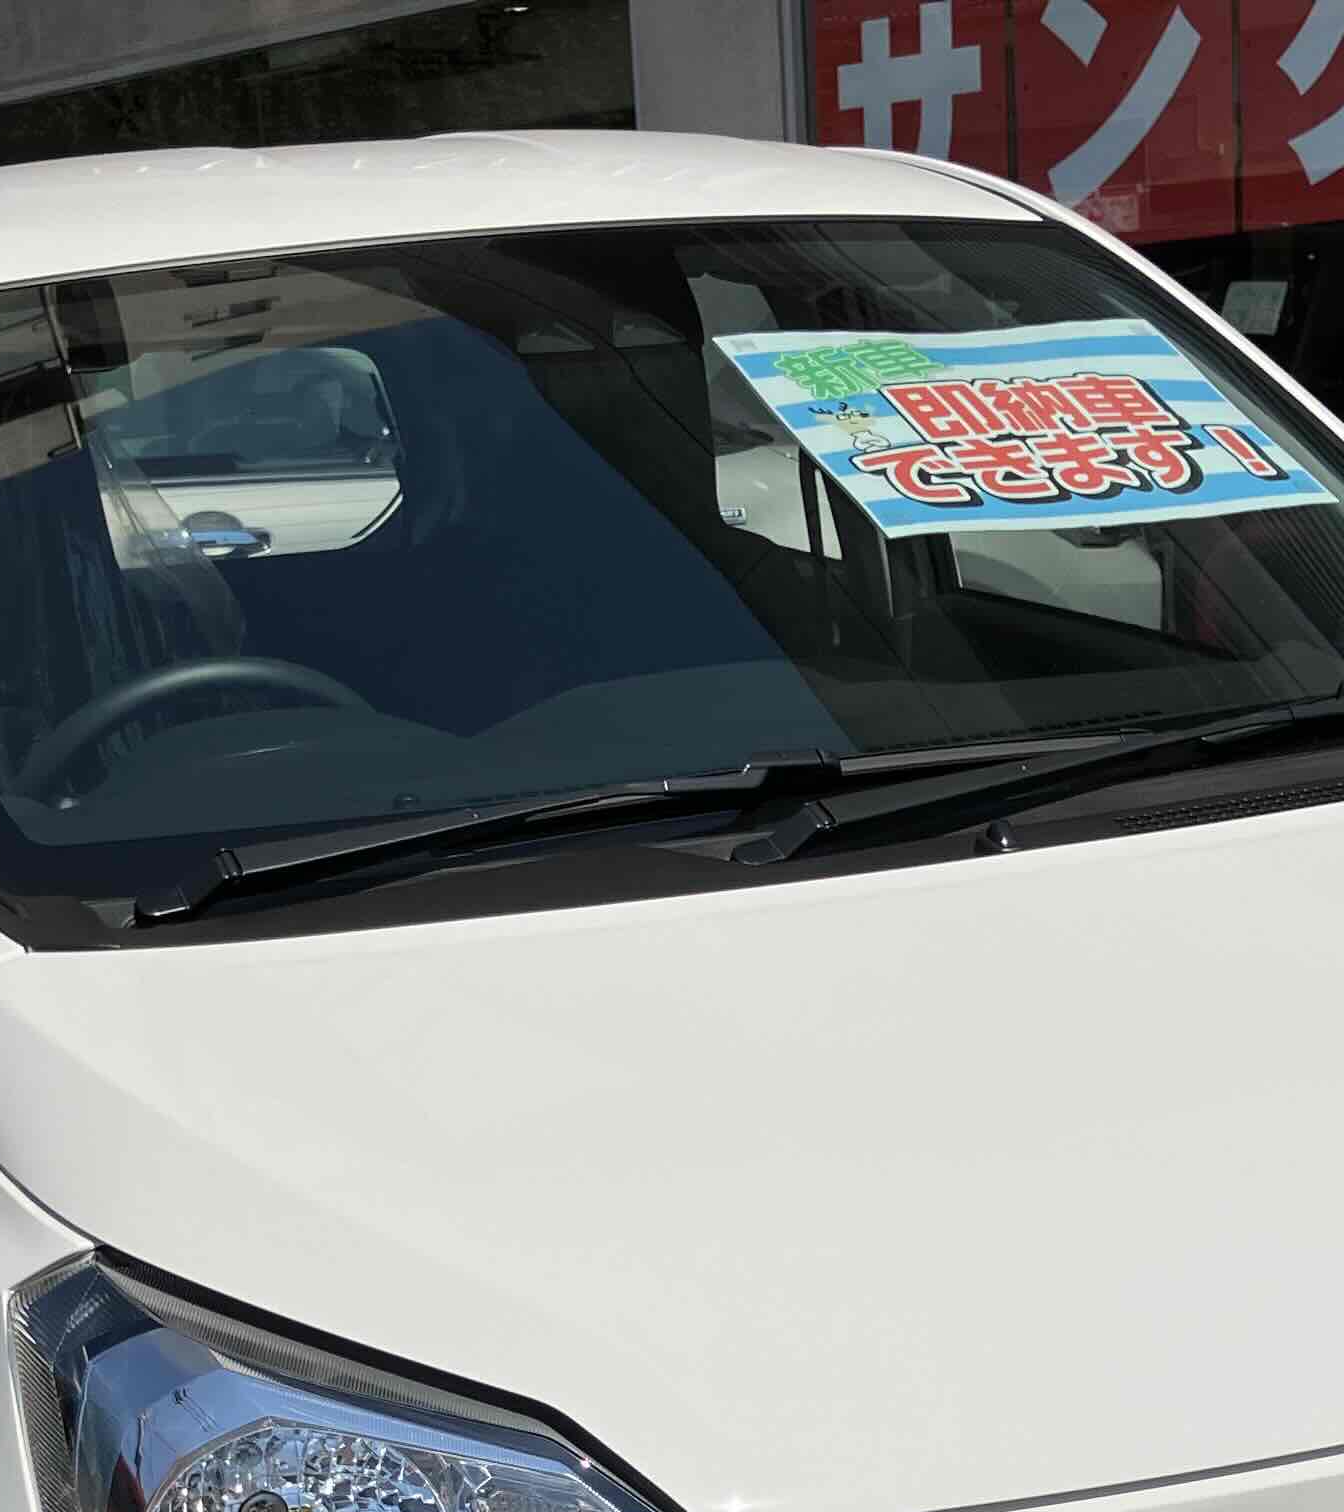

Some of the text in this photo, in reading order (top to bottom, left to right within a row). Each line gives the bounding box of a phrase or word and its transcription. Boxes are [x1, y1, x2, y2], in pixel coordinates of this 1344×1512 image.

[774, 339, 944, 400] 新車
[884, 374, 1178, 442] 即納車
